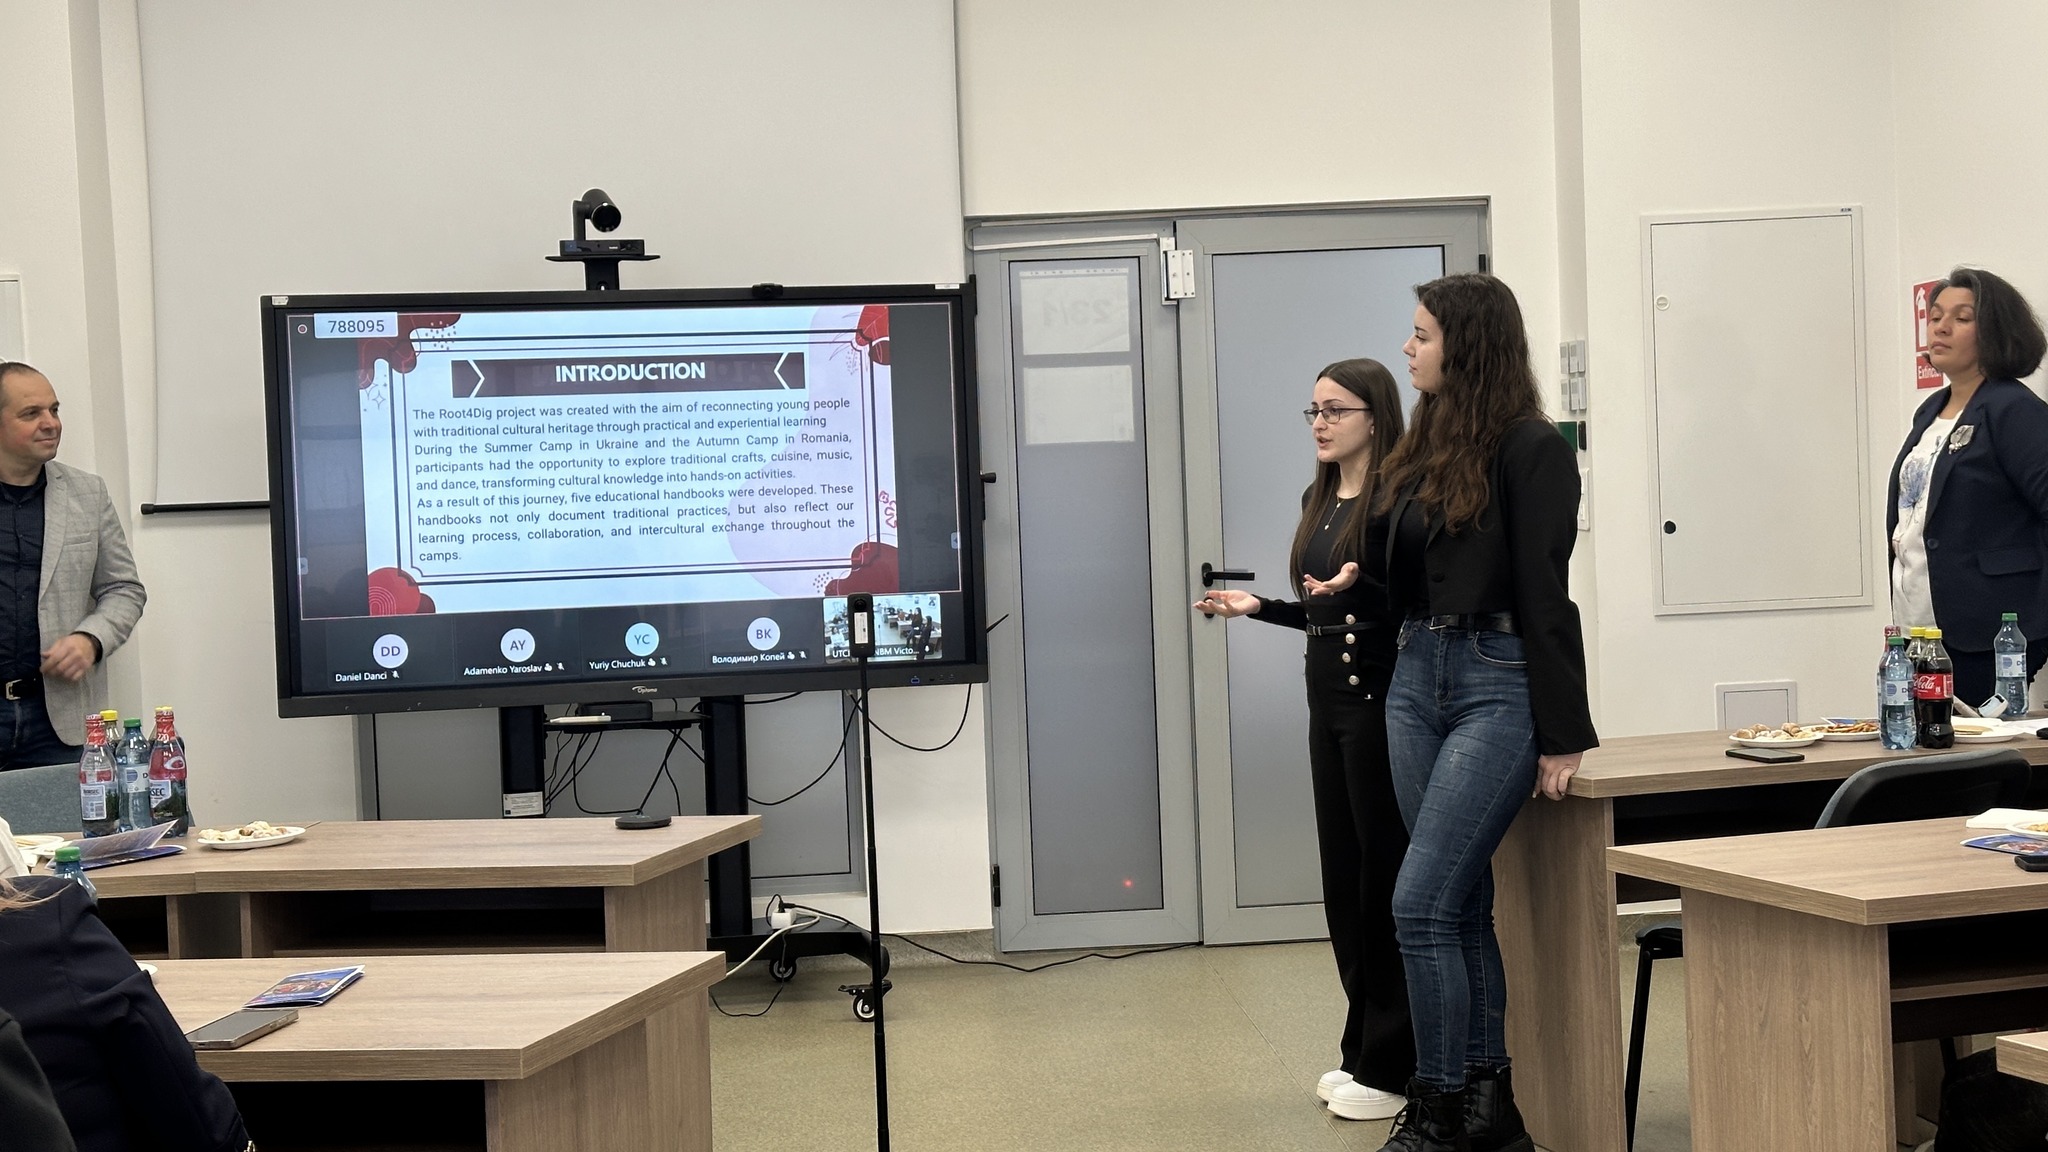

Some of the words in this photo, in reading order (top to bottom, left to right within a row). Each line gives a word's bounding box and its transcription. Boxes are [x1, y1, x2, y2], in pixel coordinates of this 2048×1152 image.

[328, 320, 385, 333] 788095
[555, 362, 706, 382] INTRODUCTION
[412, 409, 436, 419] The
[439, 408, 493, 420] Root4Dig
[496, 407, 537, 420] project
[539, 408, 563, 416] was
[566, 404, 609, 415] created
[612, 404, 637, 414] with
[639, 403, 659, 413] the
[661, 403, 683, 413] aim
[686, 401, 699, 412] of
[701, 401, 774, 412] reconnecting
[776, 401, 810, 412] young
[813, 398, 851, 411] people
[413, 426, 439, 437] with
[441, 424, 500, 437] traditional
[502, 423, 545, 435] cultural
[547, 423, 594, 435] heritage
[596, 421, 640, 434] through
[643, 419, 691, 433] practical
[694, 419, 715, 429] and
[717, 416, 781, 431] experiential
[783, 416, 827, 428] learning
[414, 444, 453, 457] During
[458, 443, 478, 454] the
[484, 443, 534, 453] Summer
[539, 441, 573, 453] Camp
[579, 440, 590, 450] in
[595, 438, 639, 450] Ukraine
[644, 437, 666, 448] and
[671, 437, 690, 447] the
[695, 437, 740, 446] Autumn
[745, 435, 779, 447] Camp
[784, 434, 795, 444] in
[800, 432, 852, 444] Romania,
[415, 462, 484, 475] participants
[488, 459, 511, 470] had
[515, 459, 535, 470] the
[538, 457, 604, 471] opportunity
[607, 457, 621, 467] to
[624, 455, 666, 468] explore
[670, 453, 727, 465] traditional
[731, 452, 767, 464] crafts,
[770, 451, 813, 463] cuisine,
[816, 449, 853, 461] music,
[416, 480, 438, 490] and
[440, 479, 479, 491] dance,
[481, 476, 556, 488] transforming
[557, 474, 601, 486] cultural
[603, 473, 664, 485] knowledge
[666, 472, 688, 482] into
[690, 470, 742, 481] hands-on
[744, 469, 796, 479] activities.
[416, 498, 433, 508] As
[446, 496, 480, 507] result
[482, 495, 496, 506] of
[498, 495, 520, 505] this
[522, 495, 568, 508] journey,
[570, 492, 592, 503] five
[594, 489, 660, 502] educational
[663, 488, 725, 499] handbooks
[727, 489, 755, 497] were
[757, 484, 817, 497] developed.
[819, 484, 854, 494] These
[417, 514, 482, 526] handbooks
[489, 514, 510, 523] not
[516, 511, 541, 524] only
[547, 510, 606, 521] document
[612, 507, 670, 519] traditional
[676, 506, 731, 520] practices,
[737, 504, 757, 514] but
[763, 503, 787, 513] also
[793, 501, 830, 512] reflect
[835, 503, 855, 511] our
[418, 533, 465, 544] learning
[471, 532, 521, 545] process,
[527, 527, 604, 540] collaboration,
[610, 525, 632, 536] and
[638, 523, 705, 535] intercultural
[711, 521, 765, 533] exchange
[770, 519, 831, 531] throughout
[836, 517, 856, 528] the
[418, 552, 462, 563] camps.
[509, 640, 526, 651] AY
[633, 634, 651, 645] YC
[380, 646, 401, 657] DD
[712, 655, 758, 665] Володимир
[760, 652, 785, 662] Копей
[464, 666, 507, 676] Adamenko
[509, 664, 542, 674] Yaroslav
[589, 661, 609, 671] Yuriy
[611, 659, 646, 669] Chuchuk
[335, 673, 361, 682] Daniel
[364, 672, 387, 682] Danci
